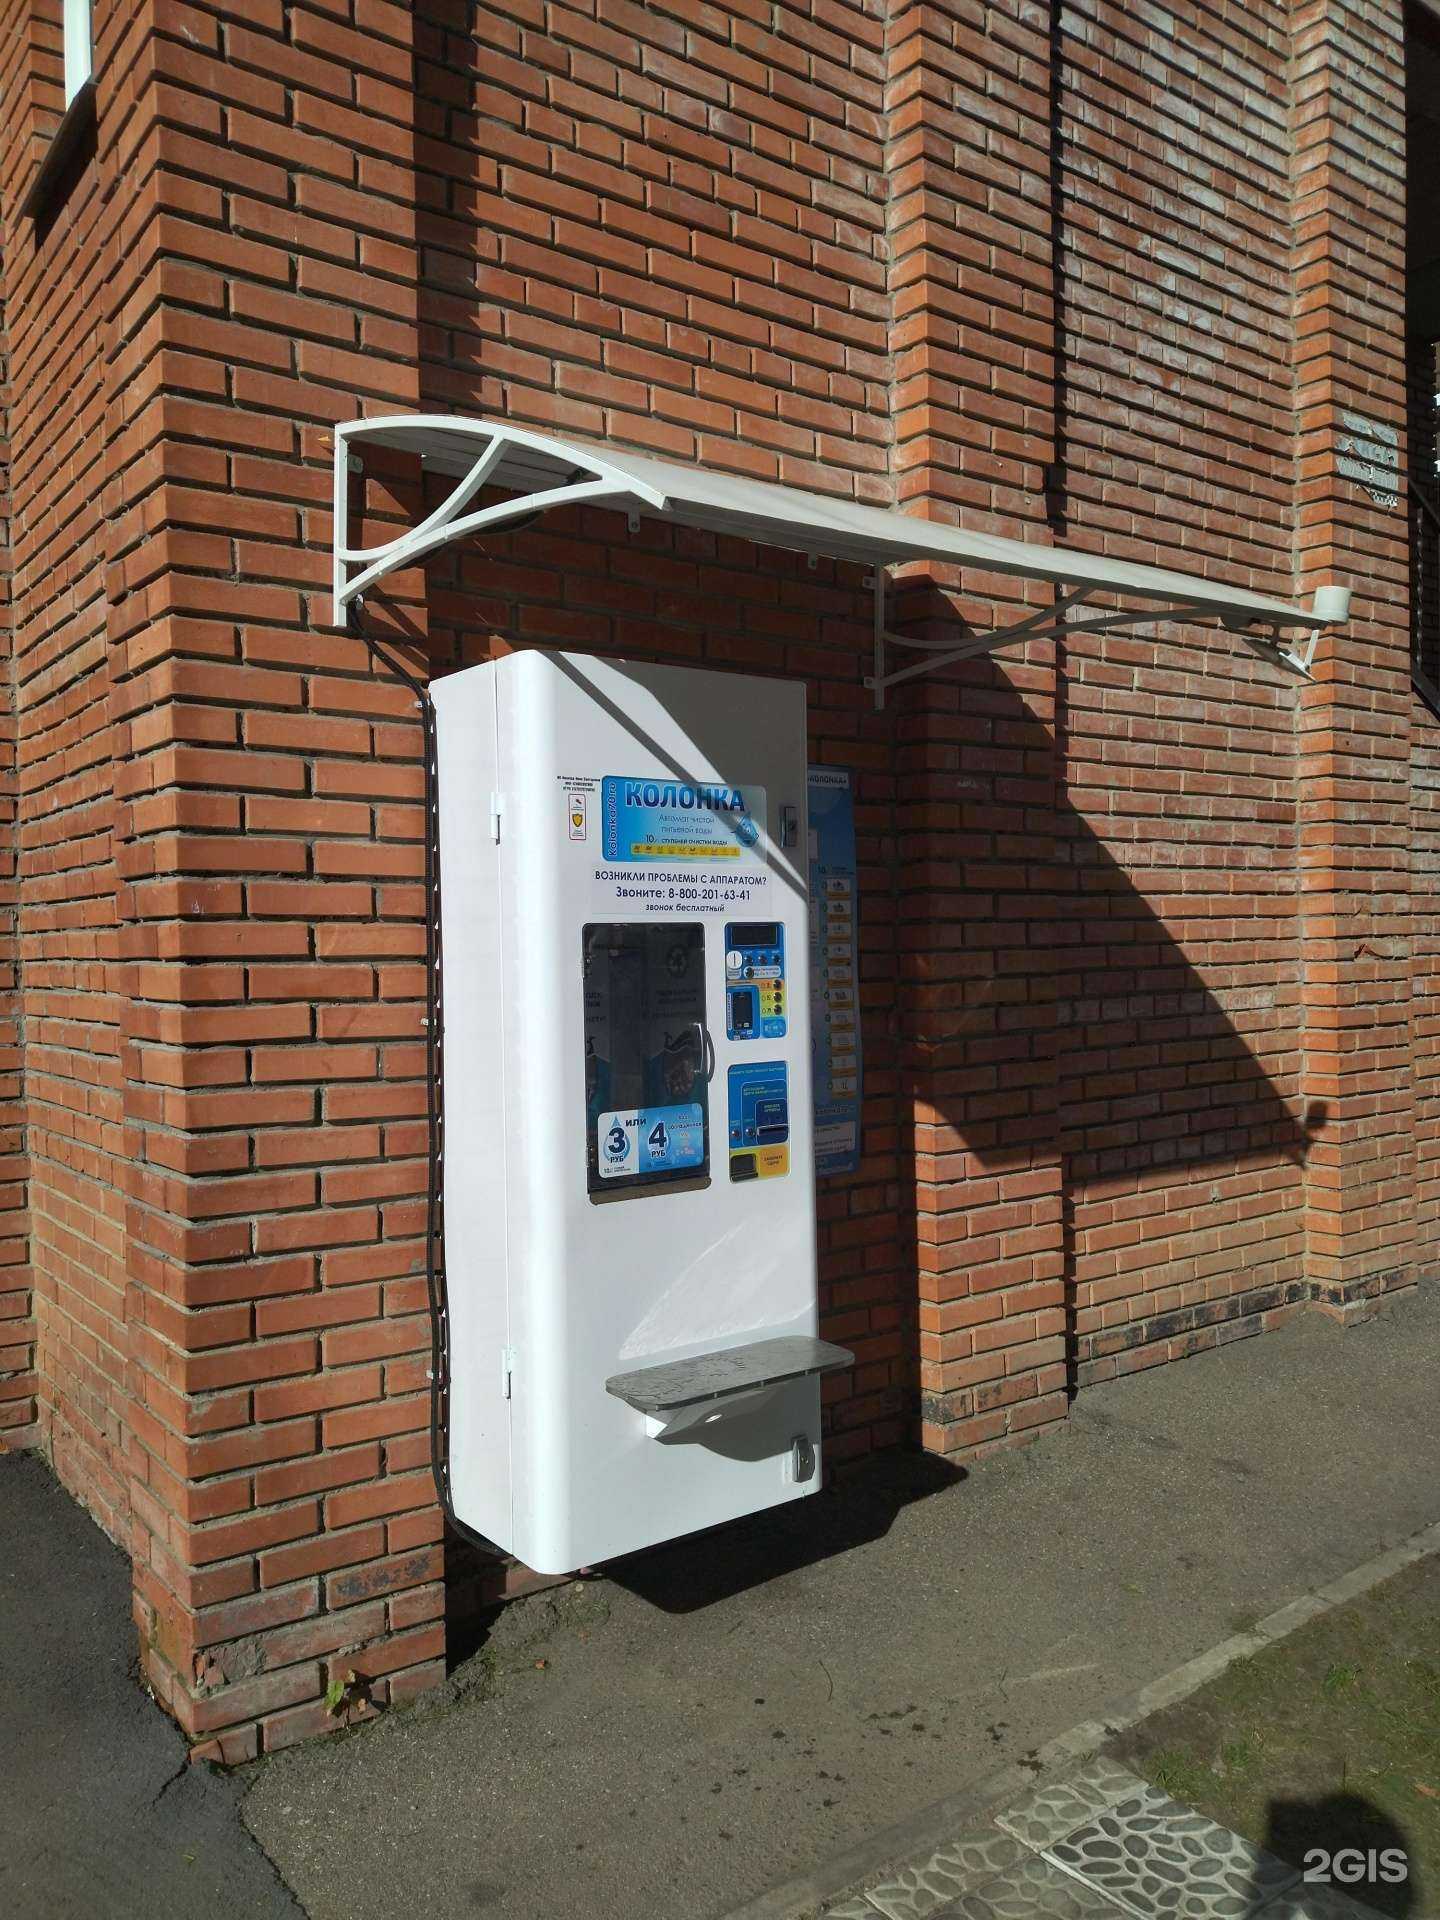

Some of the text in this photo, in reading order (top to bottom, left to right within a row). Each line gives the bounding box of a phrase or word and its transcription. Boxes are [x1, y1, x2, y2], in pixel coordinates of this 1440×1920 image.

[625, 781, 745, 811] КОЛОНКА
[595, 870, 767, 886] ВОЗНИКЛИ ПРОБЛЕМЫ С АППАРАТОМ?
[616, 886, 751, 900] Звоните: 8-800-201-63-41
[645, 903, 725, 913] звонок бесплатный
[608, 1127, 626, 1154] 3
[648, 1122, 667, 1148] 4
